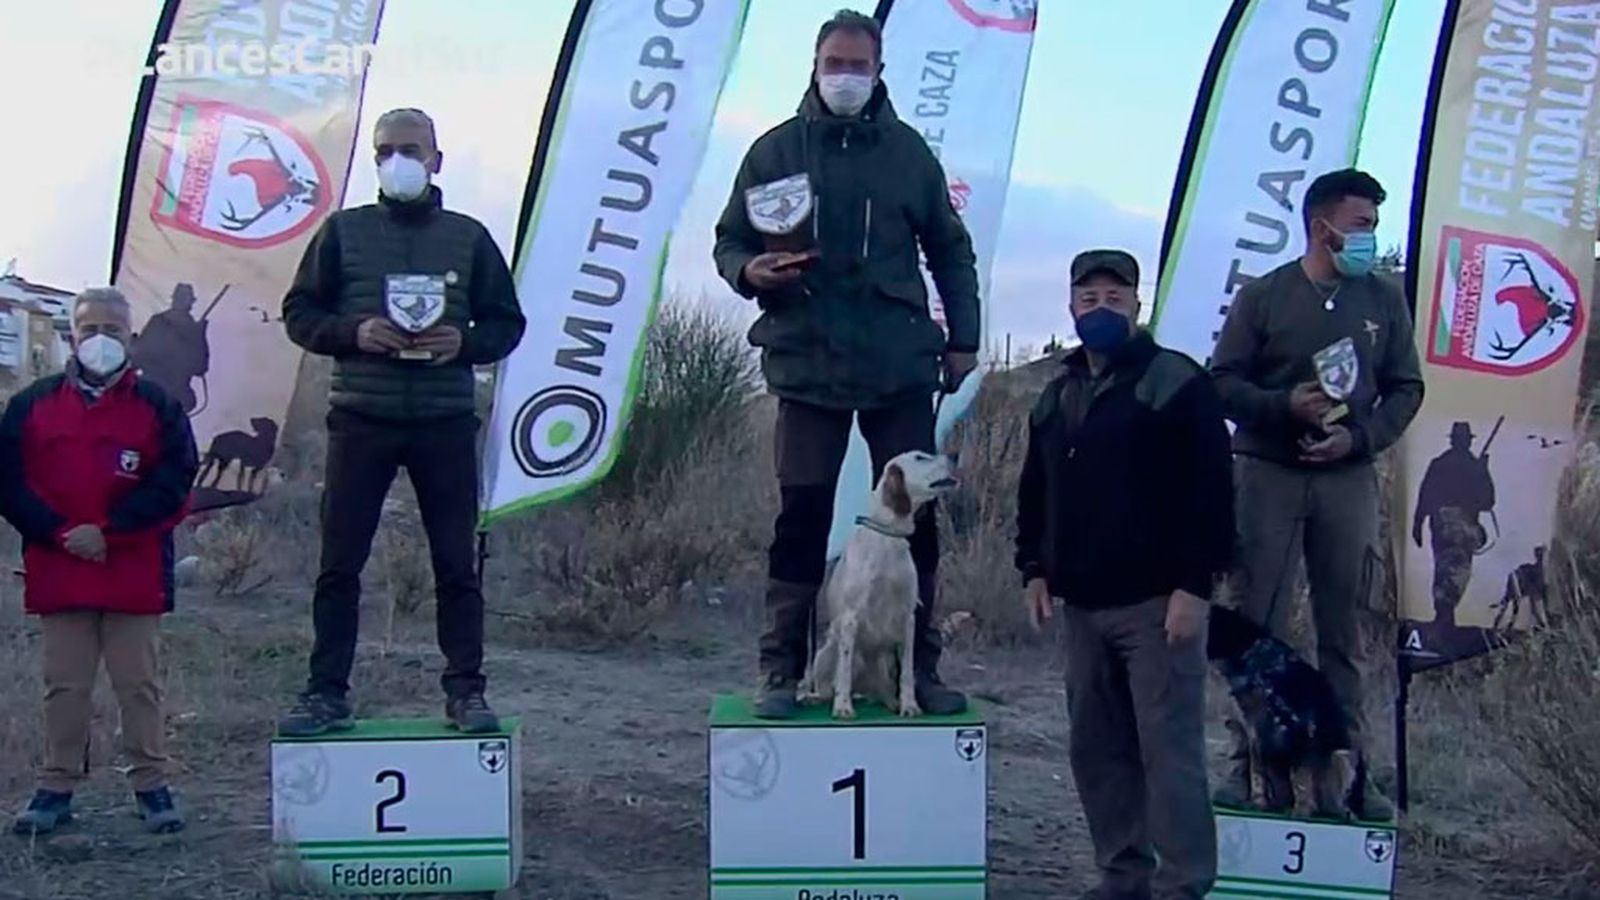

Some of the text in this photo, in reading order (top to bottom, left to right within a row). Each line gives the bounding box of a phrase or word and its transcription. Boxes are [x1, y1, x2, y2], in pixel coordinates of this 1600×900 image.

[915, 50, 960, 118] CAZA
[1521, 3, 1600, 228] ANDALUZA
[375, 769, 407, 833] 2
[832, 769, 865, 859] 1
[332, 861, 453, 887] Federación
[1282, 831, 1306, 874] 3
